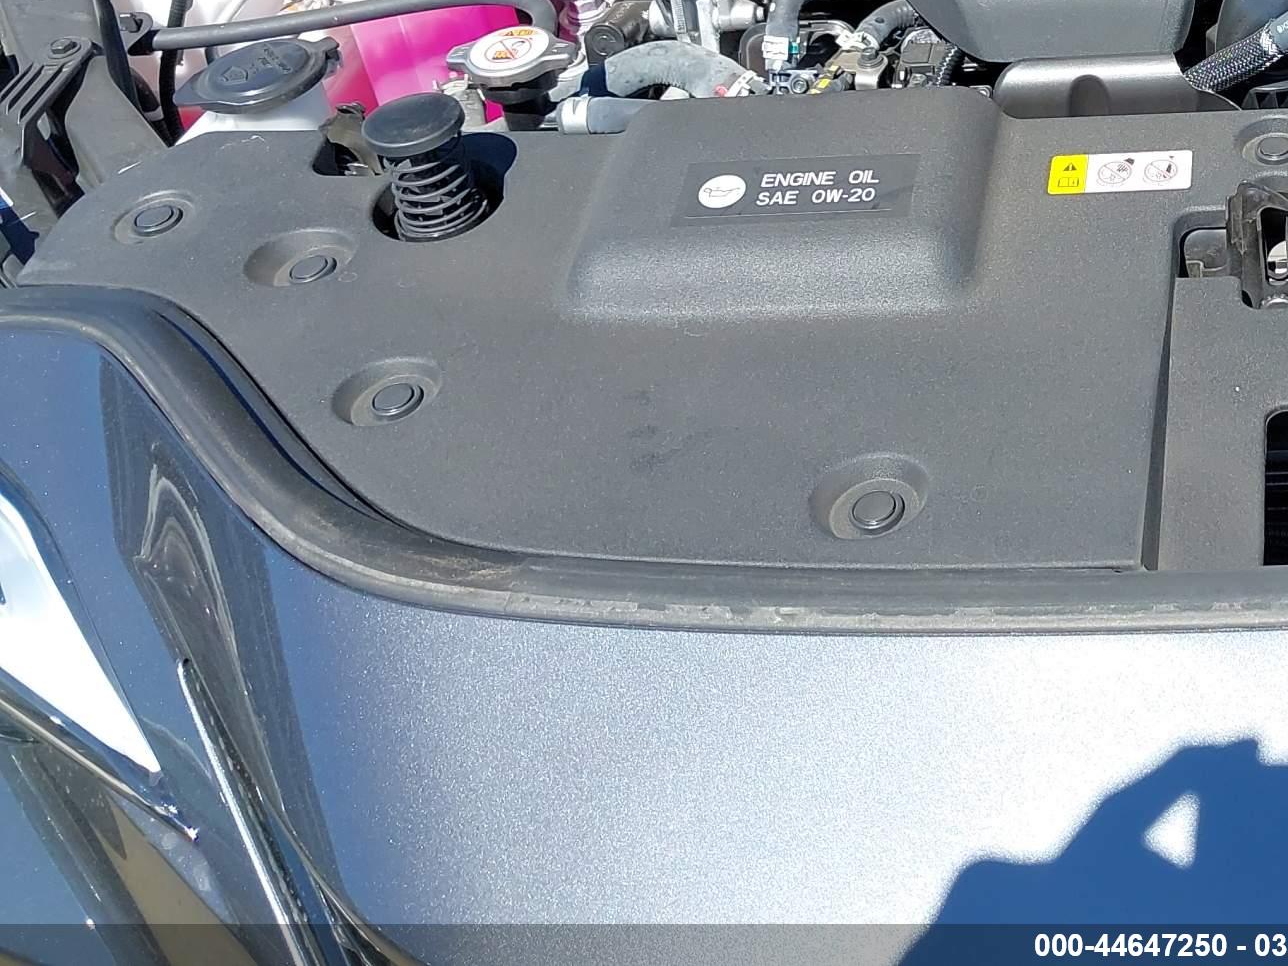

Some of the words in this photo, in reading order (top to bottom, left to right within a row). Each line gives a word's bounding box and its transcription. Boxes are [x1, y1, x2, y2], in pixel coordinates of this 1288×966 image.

[760, 170, 837, 188] ENGINE
[848, 169, 880, 184] OIL
[755, 190, 800, 206] SAE
[811, 187, 876, 204] 0W-20
